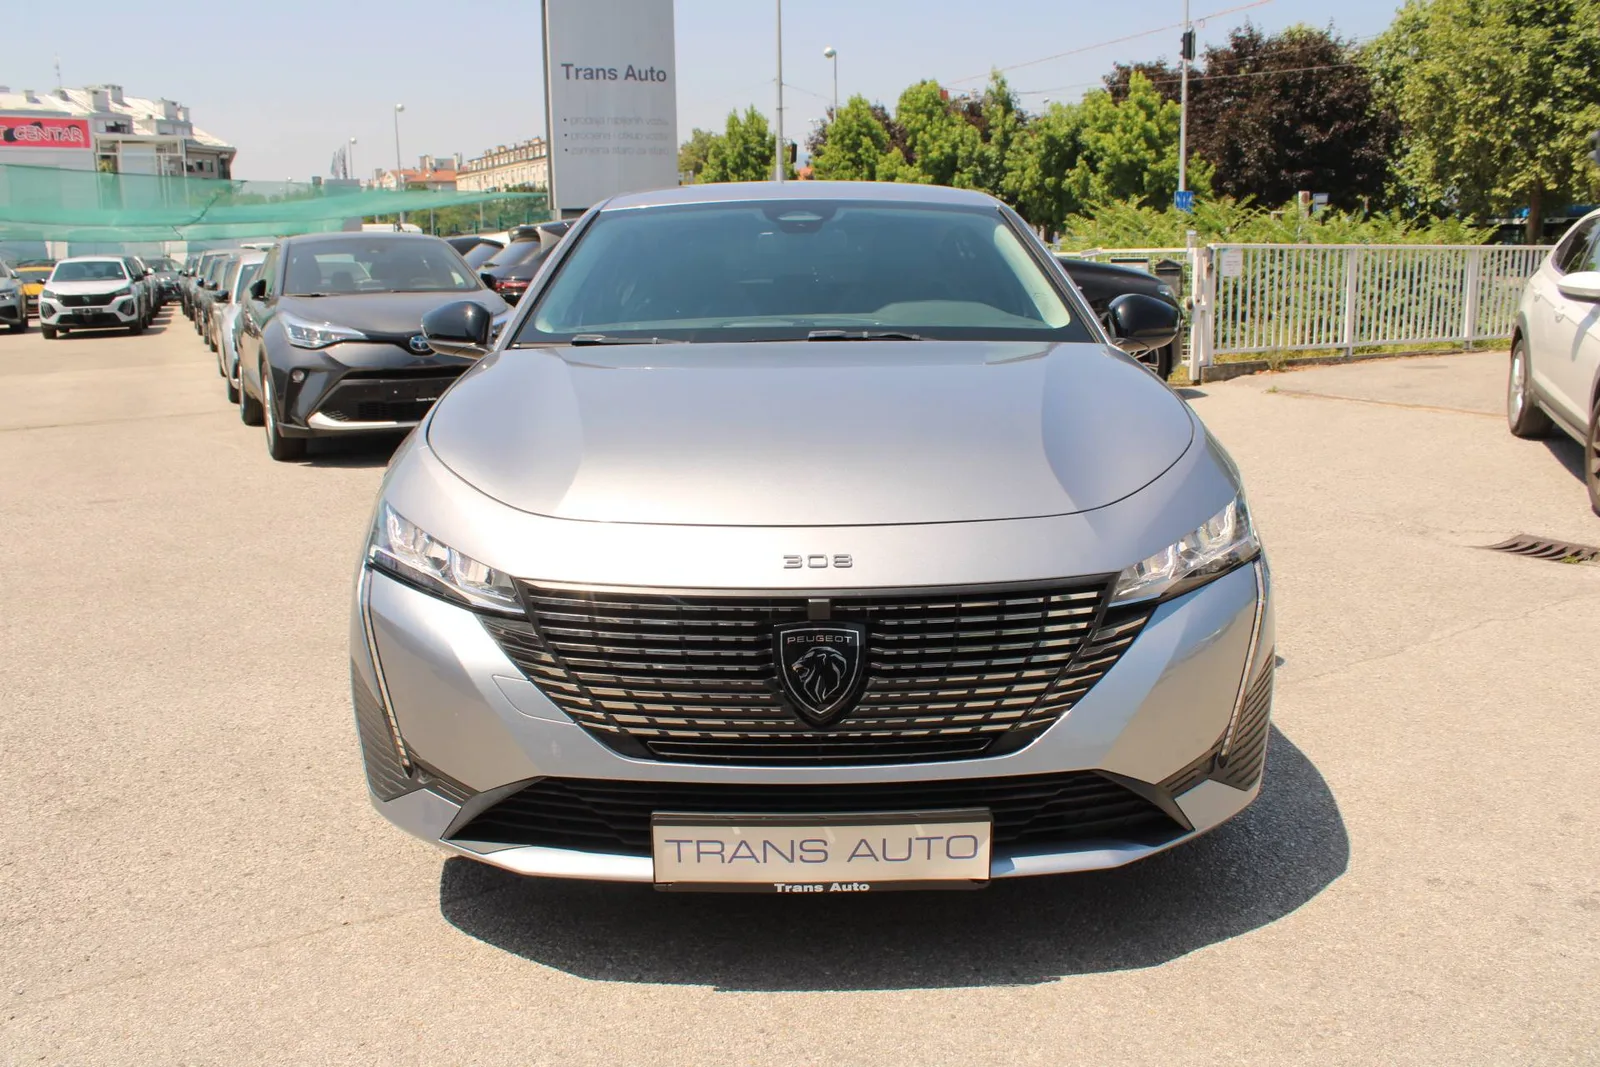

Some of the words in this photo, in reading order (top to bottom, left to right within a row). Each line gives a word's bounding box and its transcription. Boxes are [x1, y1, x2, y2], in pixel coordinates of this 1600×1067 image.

[561, 63, 618, 81] Trans
[624, 64, 667, 82] Auto
[13, 125, 83, 142] CENTAR
[783, 554, 853, 569] 308
[787, 634, 853, 644] PEUGEOT
[664, 839, 828, 864] TRANS
[847, 835, 978, 862] AUTO
[774, 883, 824, 893] Trans
[830, 881, 870, 892] Auto
